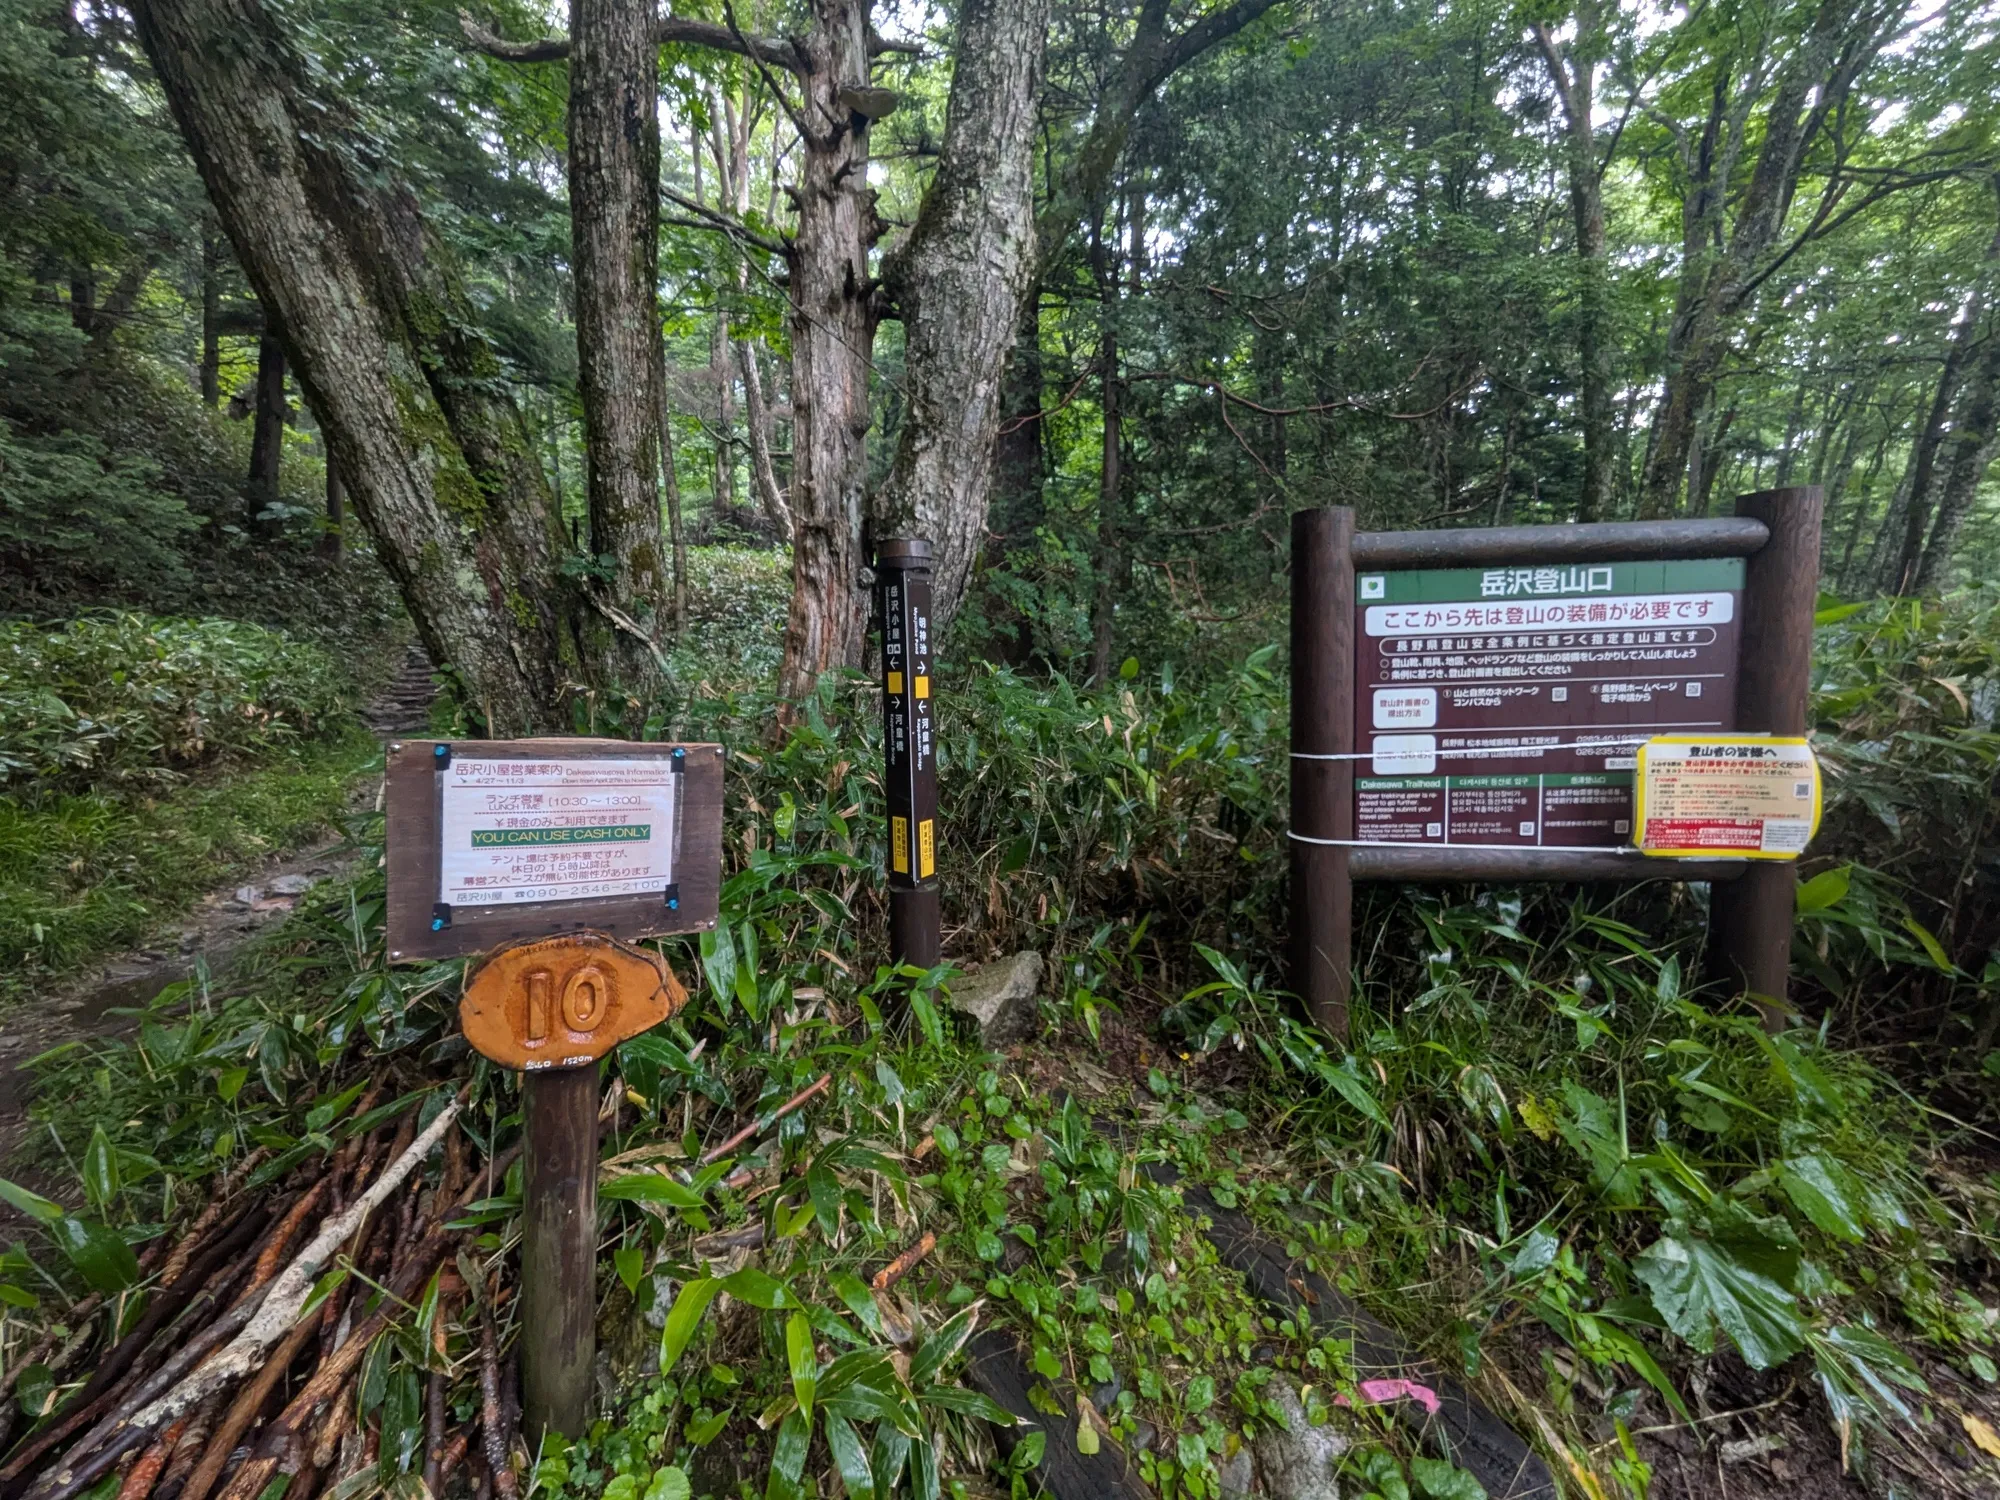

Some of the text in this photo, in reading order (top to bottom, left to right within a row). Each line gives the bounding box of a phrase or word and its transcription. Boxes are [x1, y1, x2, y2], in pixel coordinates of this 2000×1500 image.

[1480, 568, 1613, 596] 岳沢登山口
[890, 585, 900, 640] 岳沢小屋
[1384, 600, 1714, 629] ここから先は登山の装備が必要です
[1396, 631, 1698, 652] 長野県登山安全条例に基づく指定登山道です
[1689, 746, 1777, 758] 登山者の皆様へ
[456, 764, 563, 776] 岳沢小屋営業案内
[1361, 780, 1440, 789] Dakesawa Trailhead
[486, 794, 544, 804] ランチ営業
[473, 827, 650, 843] YOU CAN USE CASH ONLY
[457, 892, 503, 902] 岳沢小屋
[530, 968, 607, 1040] 10
[563, 1056, 592, 1066] 1520m
